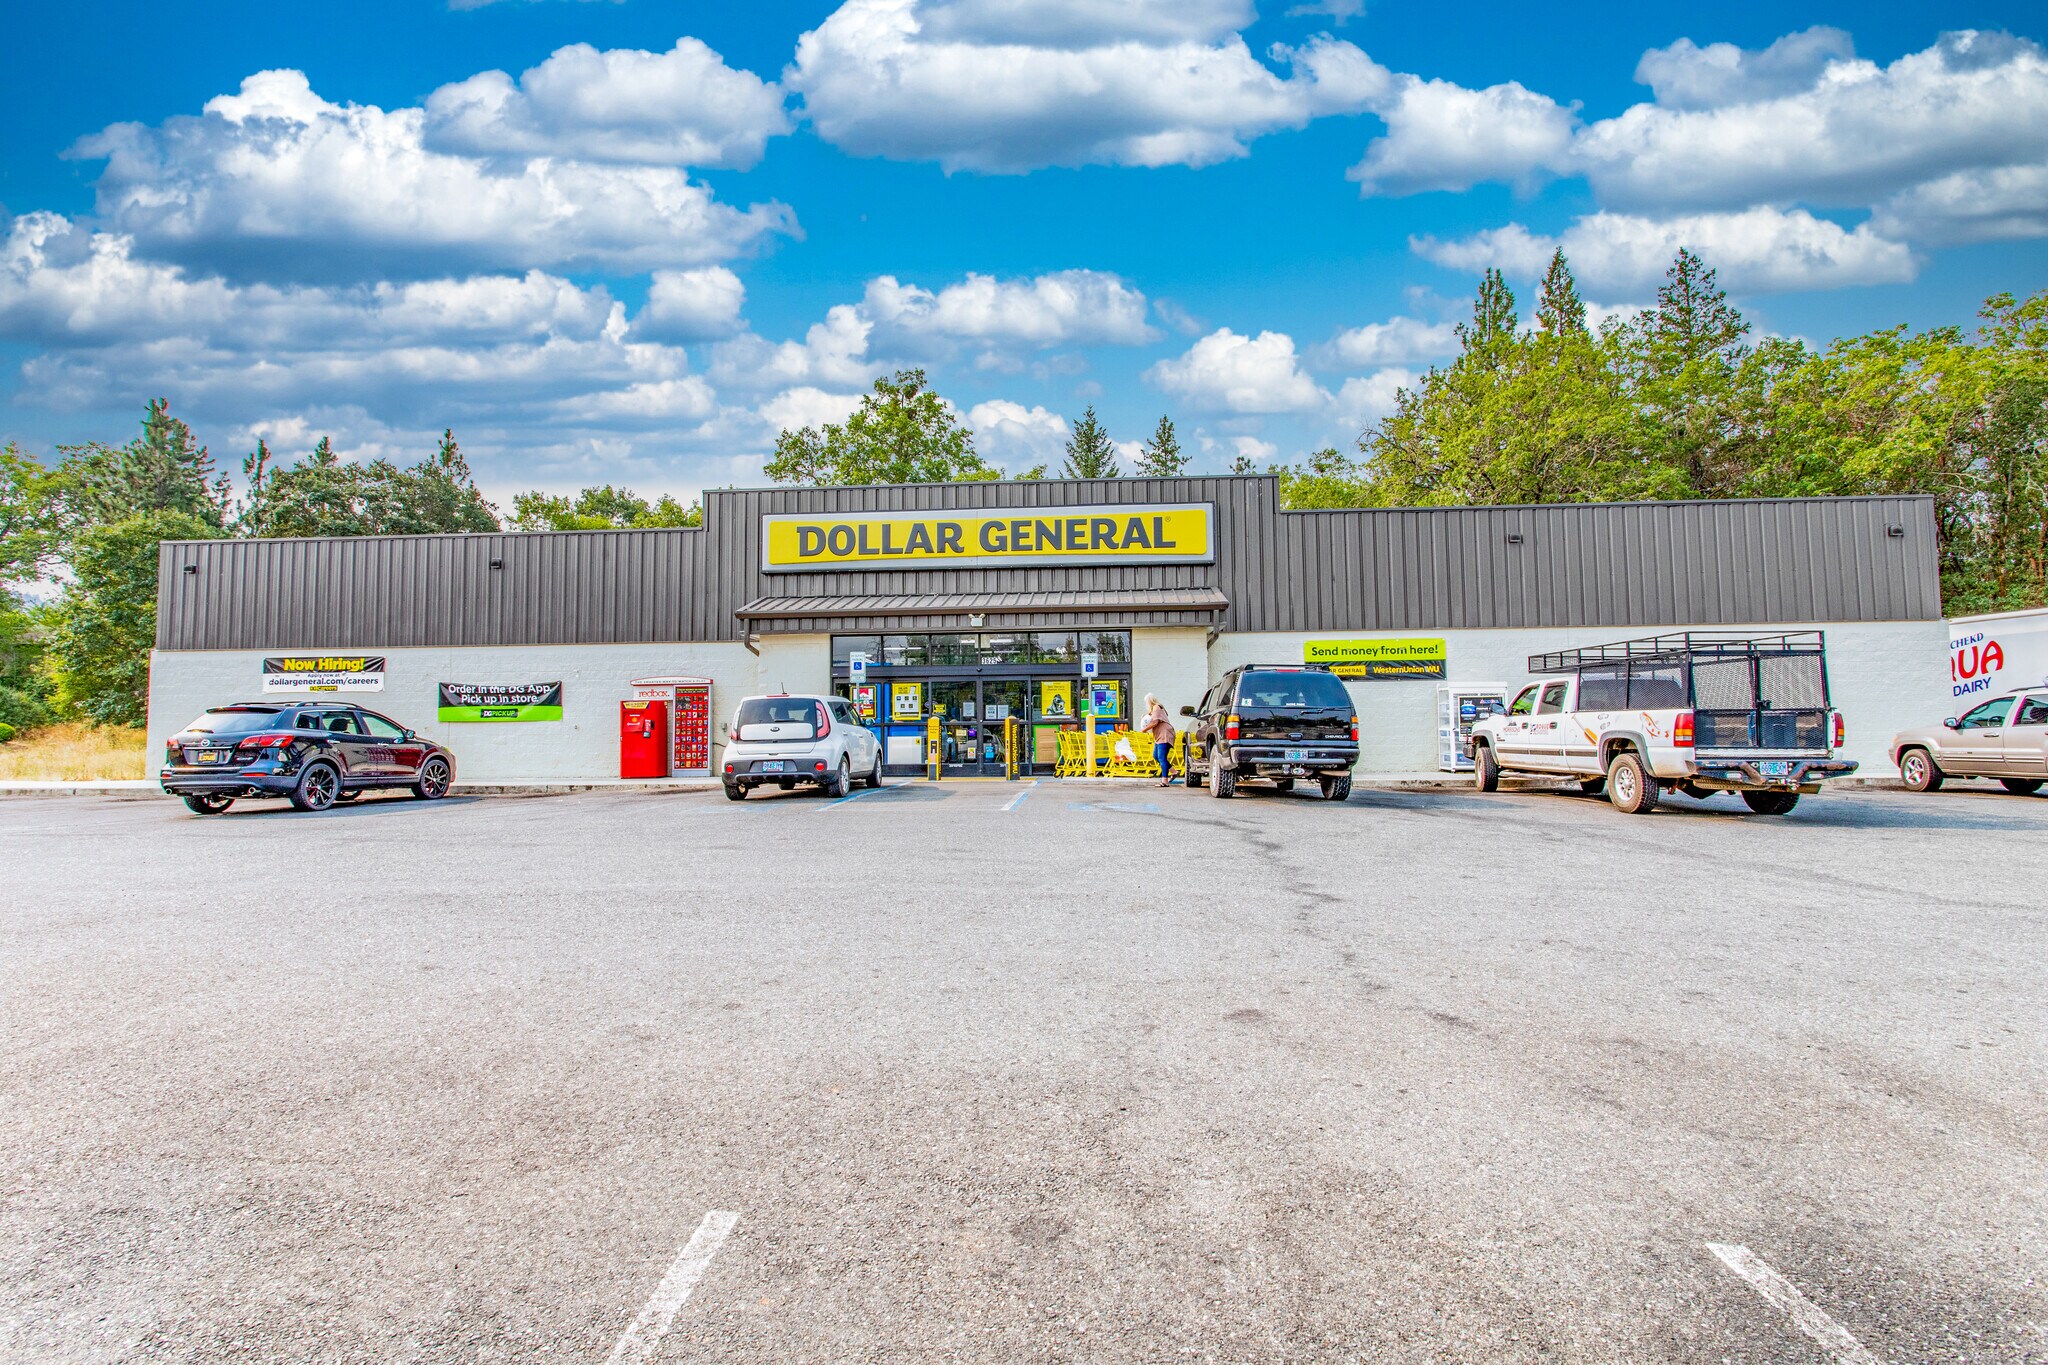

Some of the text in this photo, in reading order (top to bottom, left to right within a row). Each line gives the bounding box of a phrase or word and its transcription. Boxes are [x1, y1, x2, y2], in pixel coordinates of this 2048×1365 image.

[797, 522, 964, 557] DOLLAR
[1311, 644, 1438, 657] Send money from here!
[284, 657, 366, 672] Now Hiring!
[1373, 665, 1440, 674] WesternUnion WU
[269, 677, 379, 687] dollargeneral.com/careers
[1953, 677, 1992, 696] DAIRY
[448, 684, 552, 695] Order in the DG App.
[461, 694, 539, 705] Pick up in store.
[1013, 763, 1018, 774] WU
